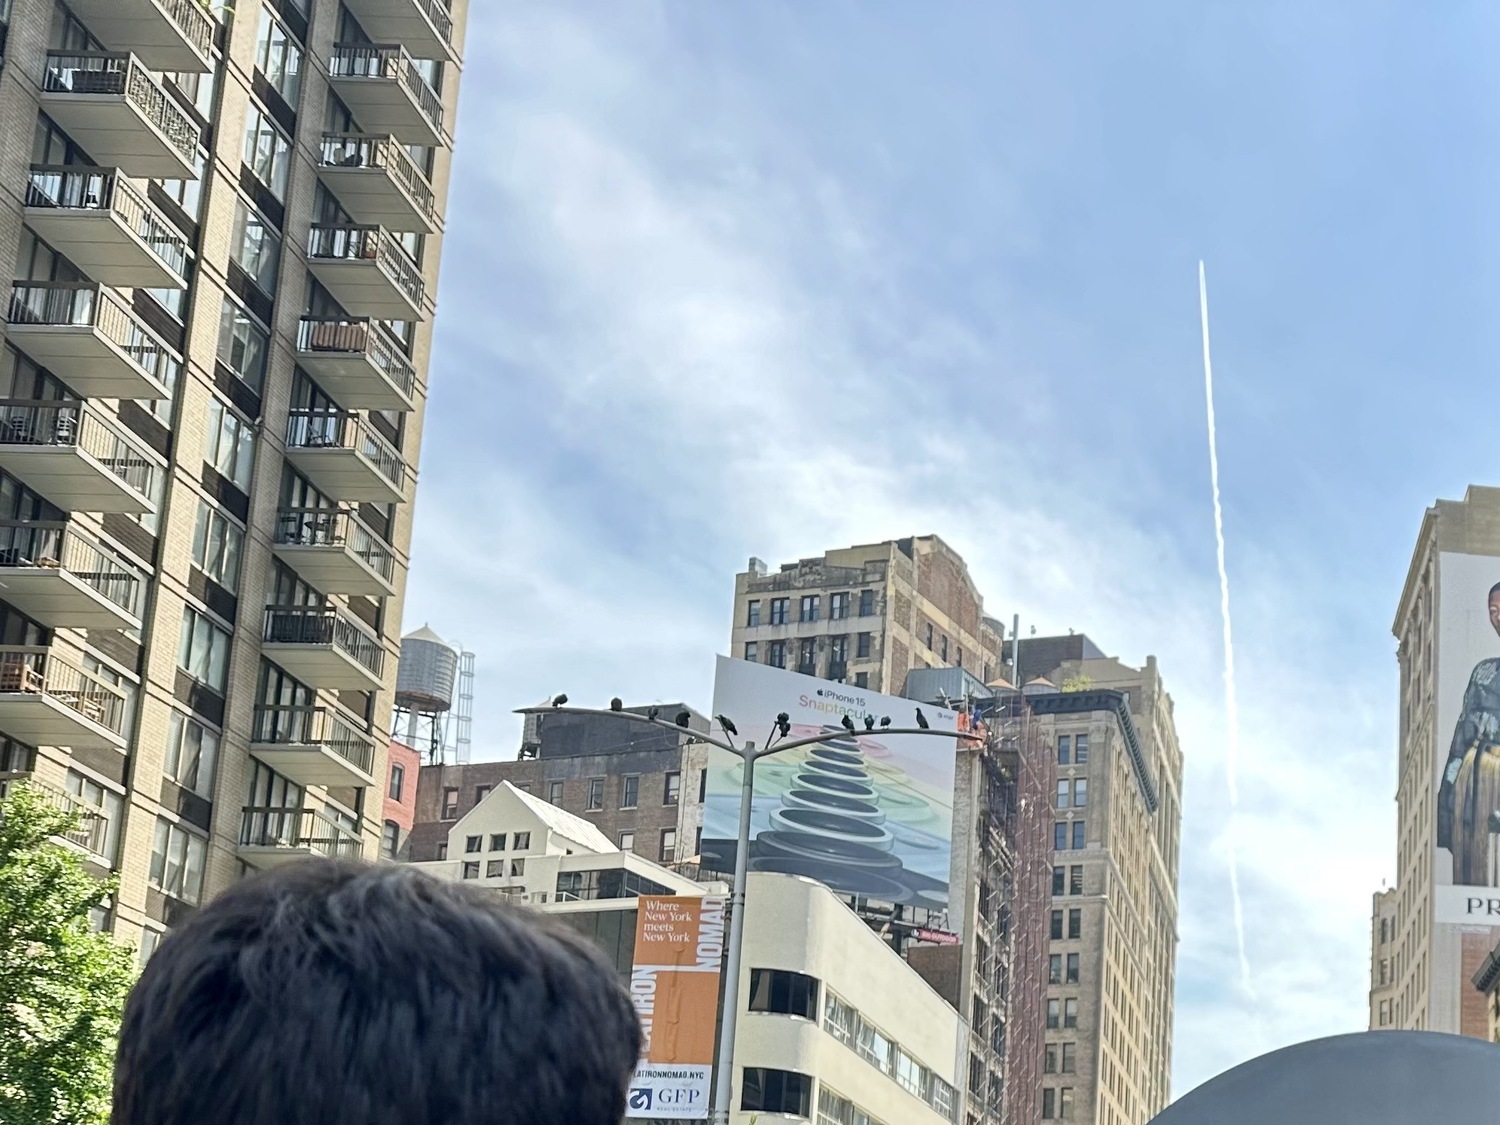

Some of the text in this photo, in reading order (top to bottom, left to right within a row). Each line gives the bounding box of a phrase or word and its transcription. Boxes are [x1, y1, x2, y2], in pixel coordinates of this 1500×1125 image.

[824, 689, 866, 707] iPhone 15
[799, 694, 879, 720] Snaptaculr
[646, 900, 680, 911] Where
[645, 911, 692, 922] New York
[644, 923, 674, 932] meets
[643, 932, 690, 943] New York
[696, 896, 725, 973] NOMAD
[658, 1088, 700, 1104] GFP
